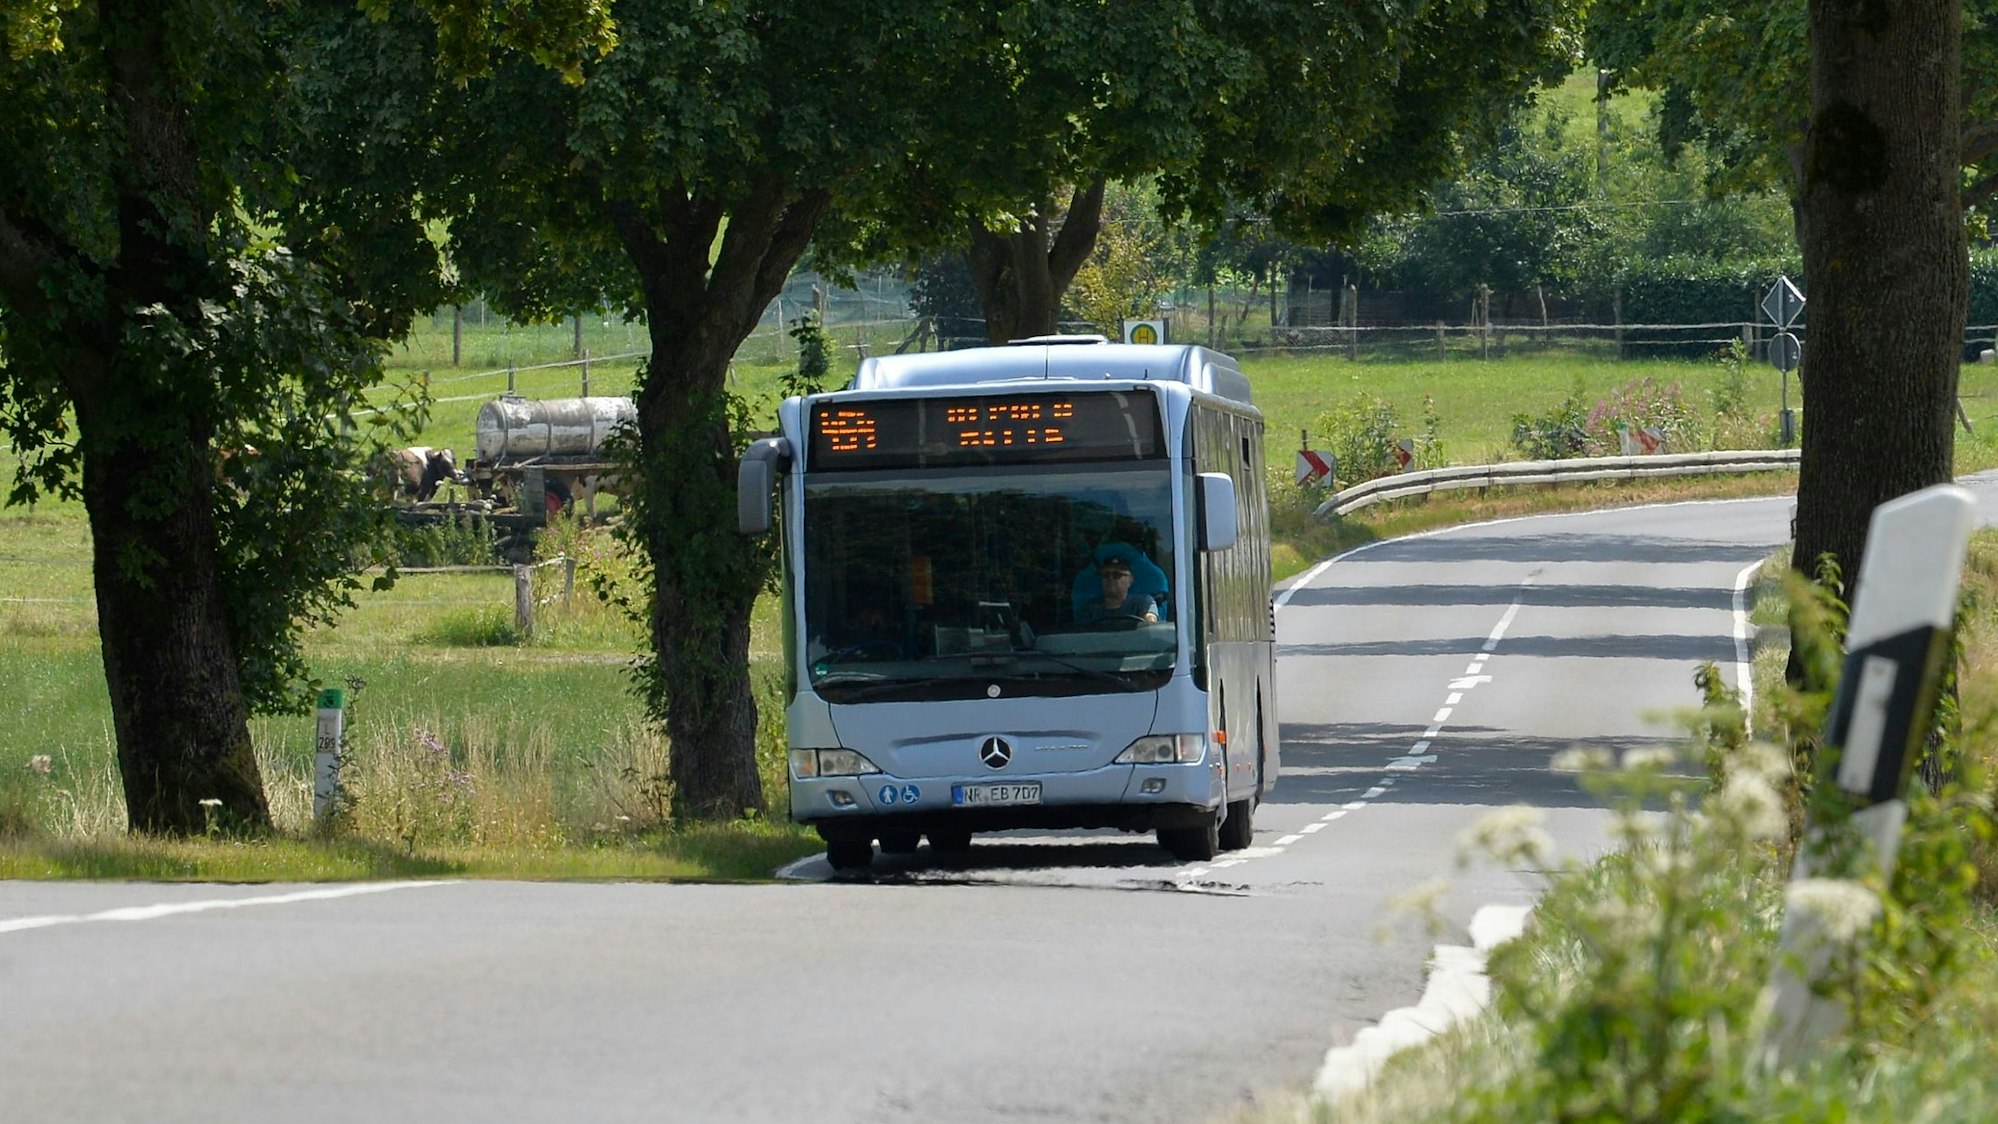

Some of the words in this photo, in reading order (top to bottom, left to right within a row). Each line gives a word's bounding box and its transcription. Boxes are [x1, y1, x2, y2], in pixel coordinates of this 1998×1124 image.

[1138, 330, 1149, 345] H
[964, 787, 983, 803] NR
[990, 787, 1009, 801] EB
